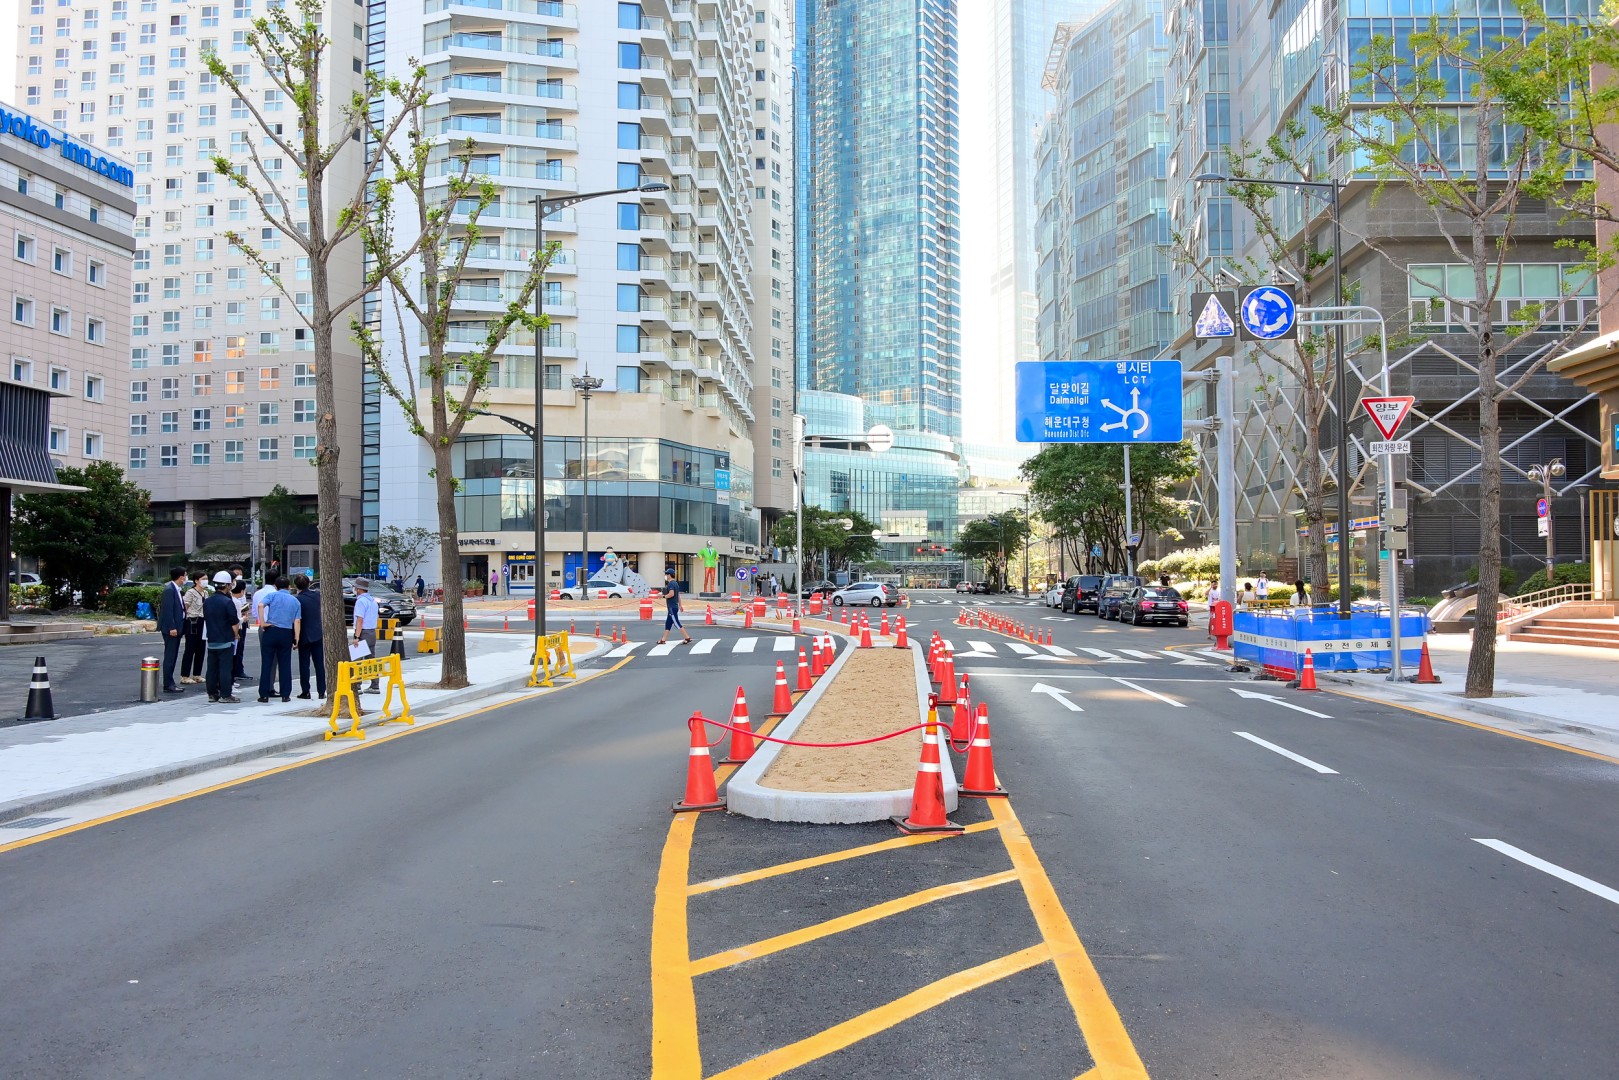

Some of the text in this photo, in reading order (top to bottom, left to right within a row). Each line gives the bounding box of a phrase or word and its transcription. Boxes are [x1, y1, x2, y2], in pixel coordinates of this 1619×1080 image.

[0, 107, 134, 188] yoko-inn.com
[1116, 361, 1151, 374] 엘시티
[1124, 375, 1147, 384] LCT
[1049, 382, 1089, 394] 달맞이길
[1049, 395, 1089, 405] Dalmajigil
[1375, 403, 1399, 412] 양보
[1044, 416, 1089, 428] 해운대구청
[1372, 442, 1408, 452] 회전 차량 우선
